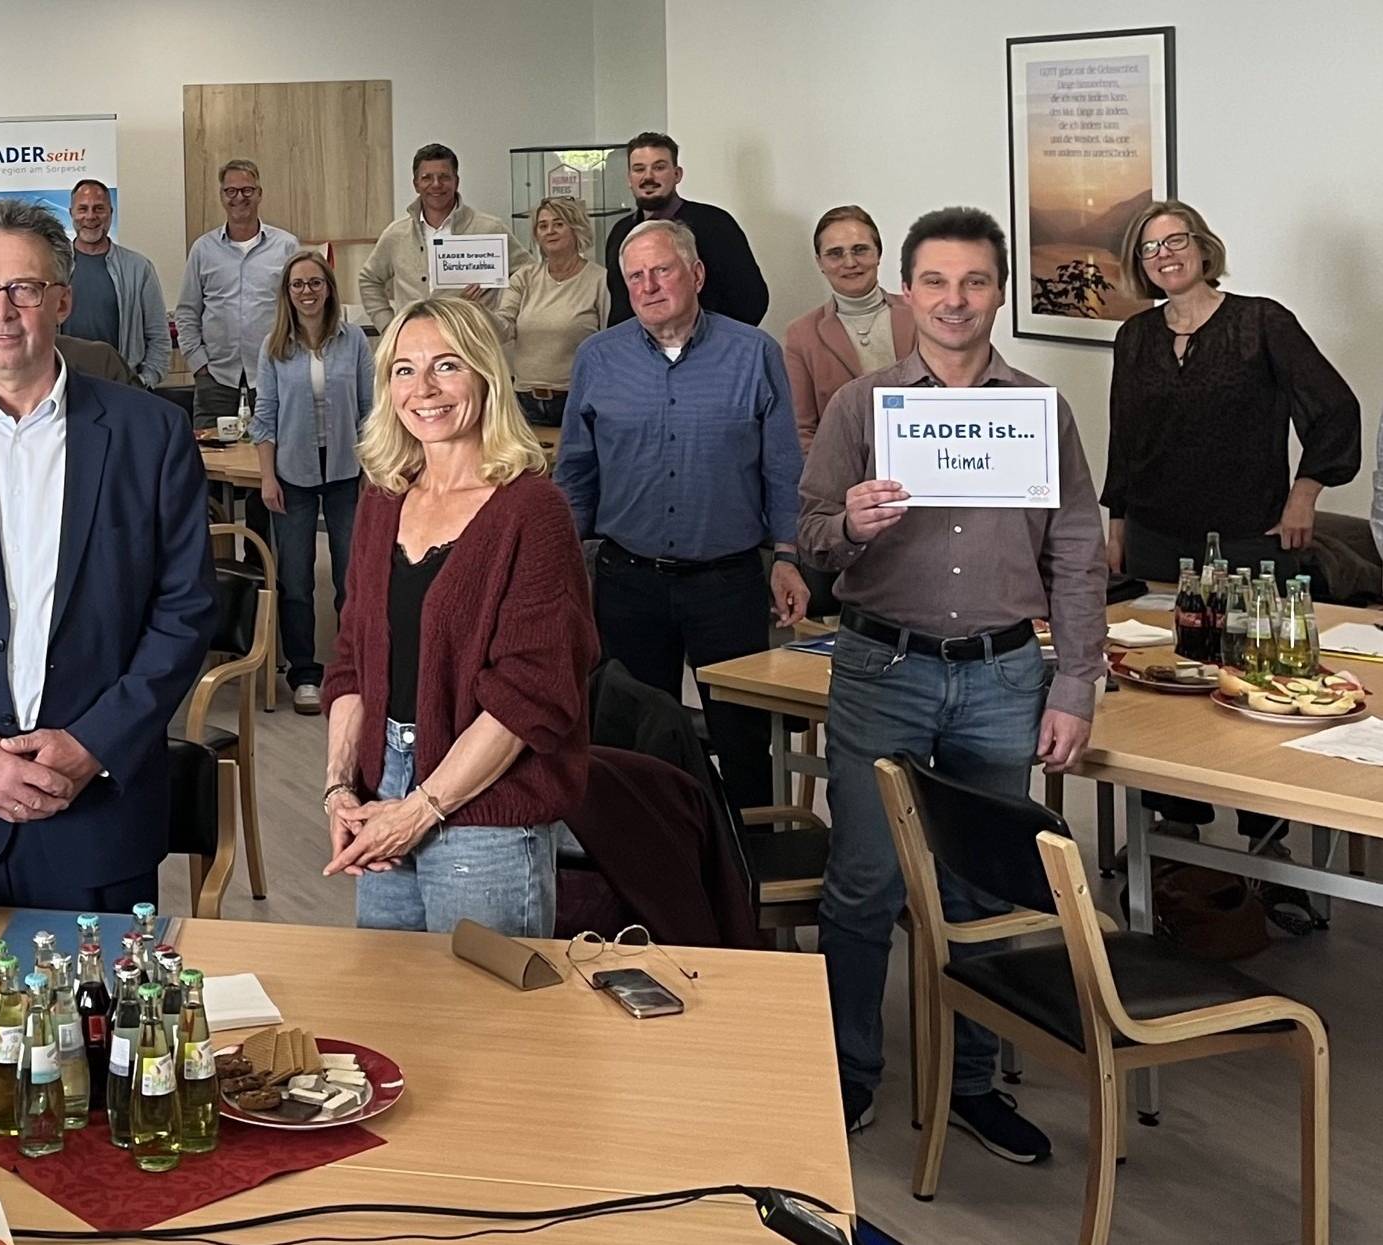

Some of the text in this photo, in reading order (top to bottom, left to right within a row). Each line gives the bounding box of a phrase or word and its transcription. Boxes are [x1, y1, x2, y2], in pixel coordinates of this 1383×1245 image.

[29, 166, 43, 174] am
[46, 164, 87, 174] Sorpesee
[552, 186, 572, 194] PREIS
[897, 421, 1036, 439] LEADER ist...
[937, 447, 995, 470] Heimat.
